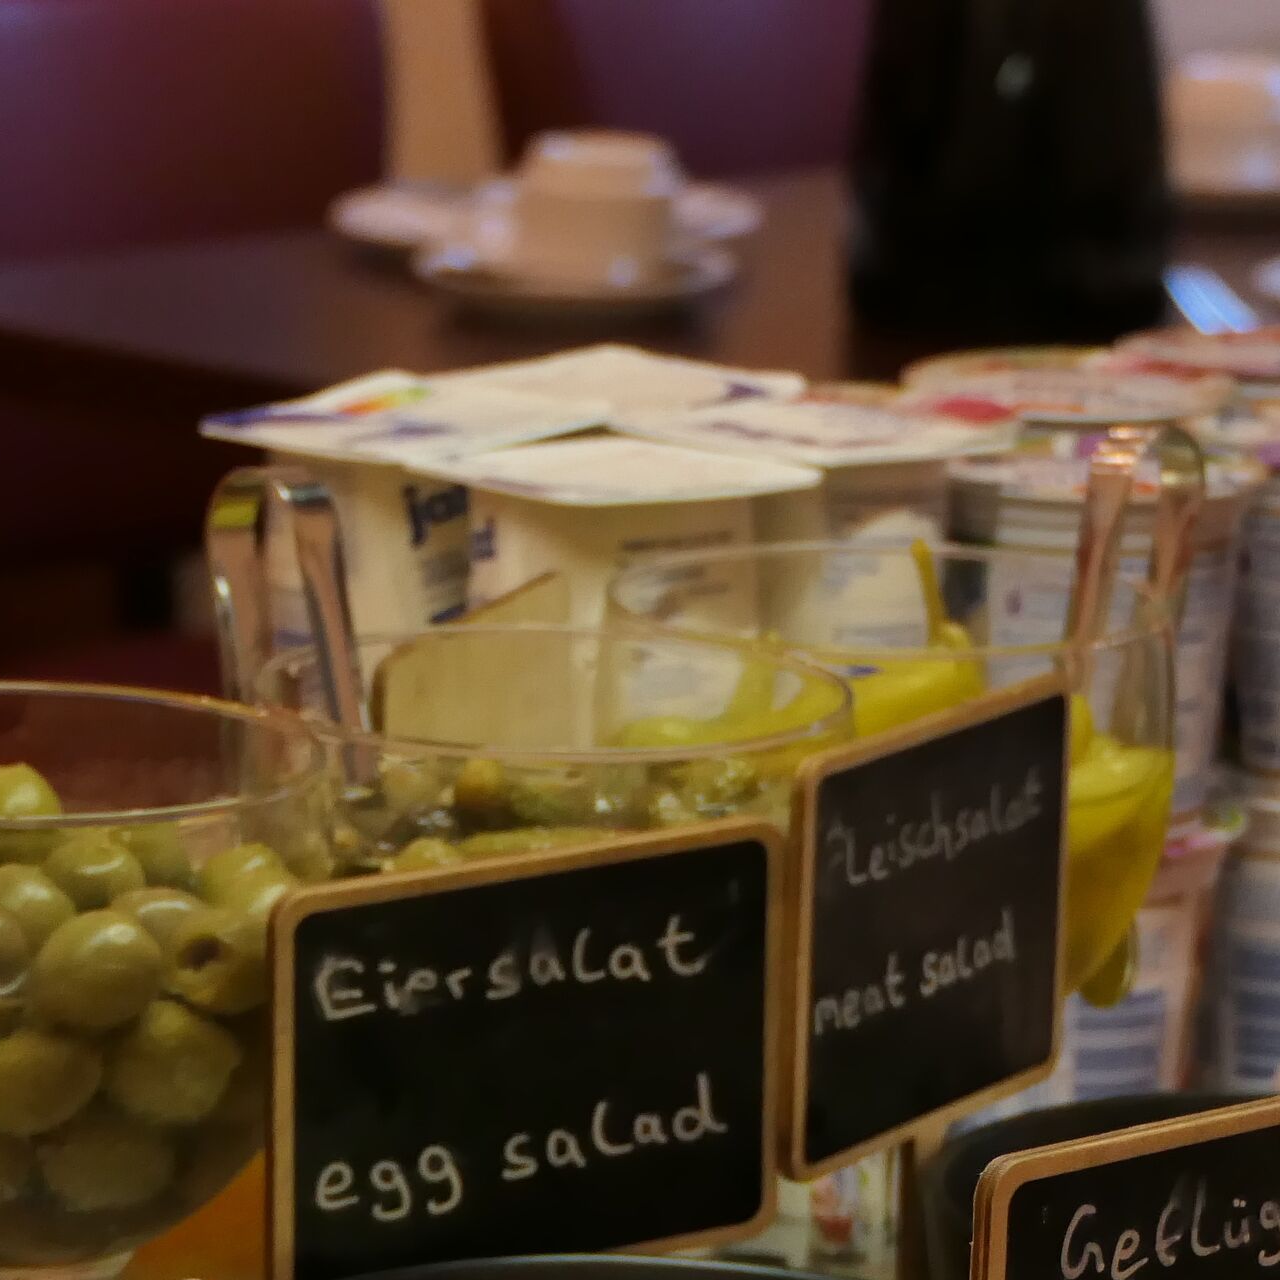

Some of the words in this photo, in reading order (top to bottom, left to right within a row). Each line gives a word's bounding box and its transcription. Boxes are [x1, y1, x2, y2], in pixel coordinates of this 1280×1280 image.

[314, 914, 710, 1021] Eiersalat
[814, 951, 907, 1036] meat
[919, 904, 1016, 997] salad
[315, 1143, 464, 1222] egg
[500, 1071, 729, 1181] salad
